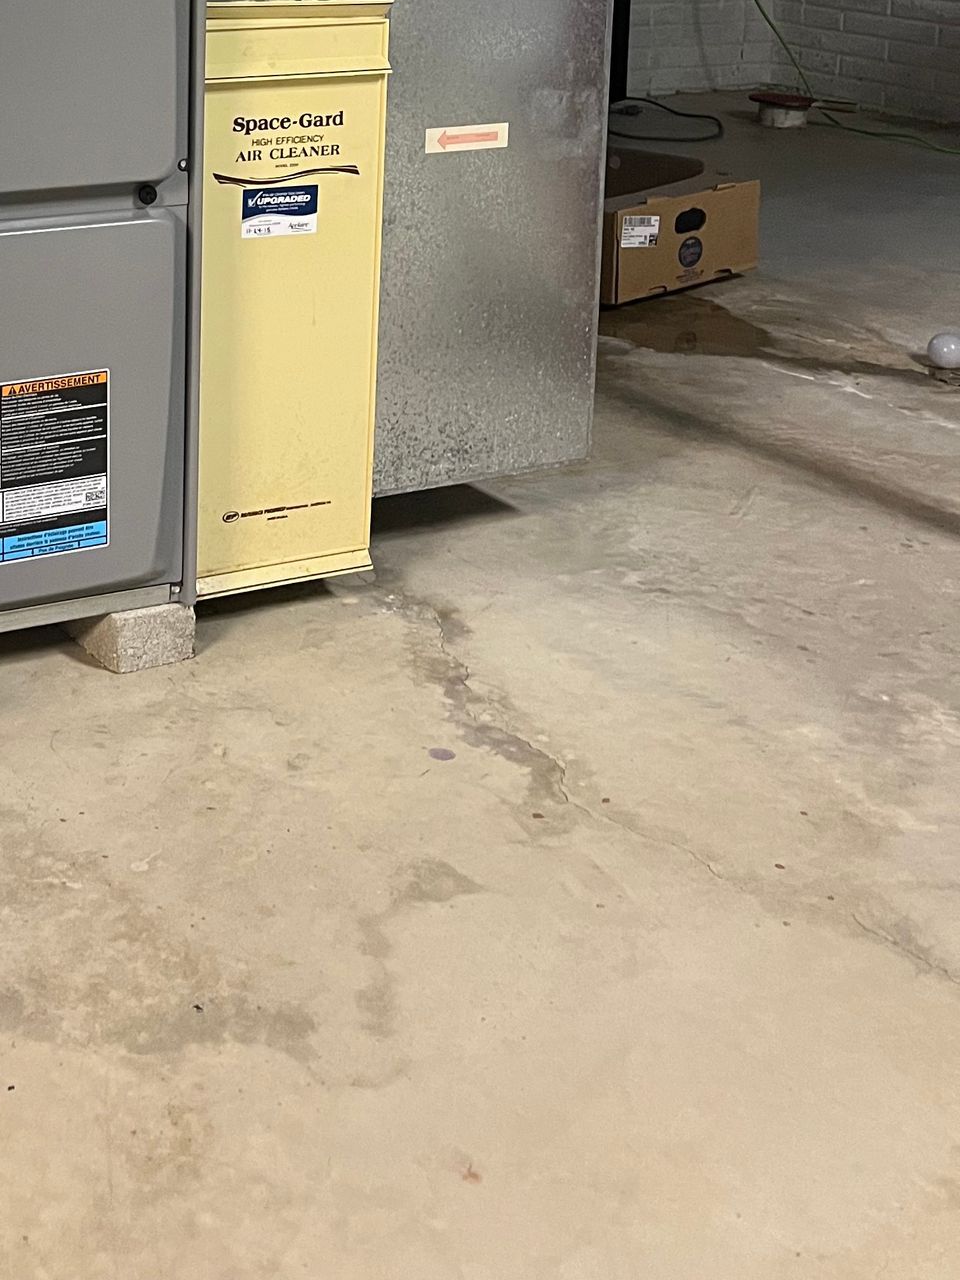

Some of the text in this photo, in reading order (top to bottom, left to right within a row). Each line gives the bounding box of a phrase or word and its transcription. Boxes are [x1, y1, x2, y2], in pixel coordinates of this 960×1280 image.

[232, 110, 344, 136] Space-Gard
[251, 134, 325, 147] HIGH EFFICIENCY
[235, 144, 341, 163] AIR CLEANER
[257, 194, 311, 205] UPGRADED
[18, 374, 101, 394] AVERTISSEMENT
